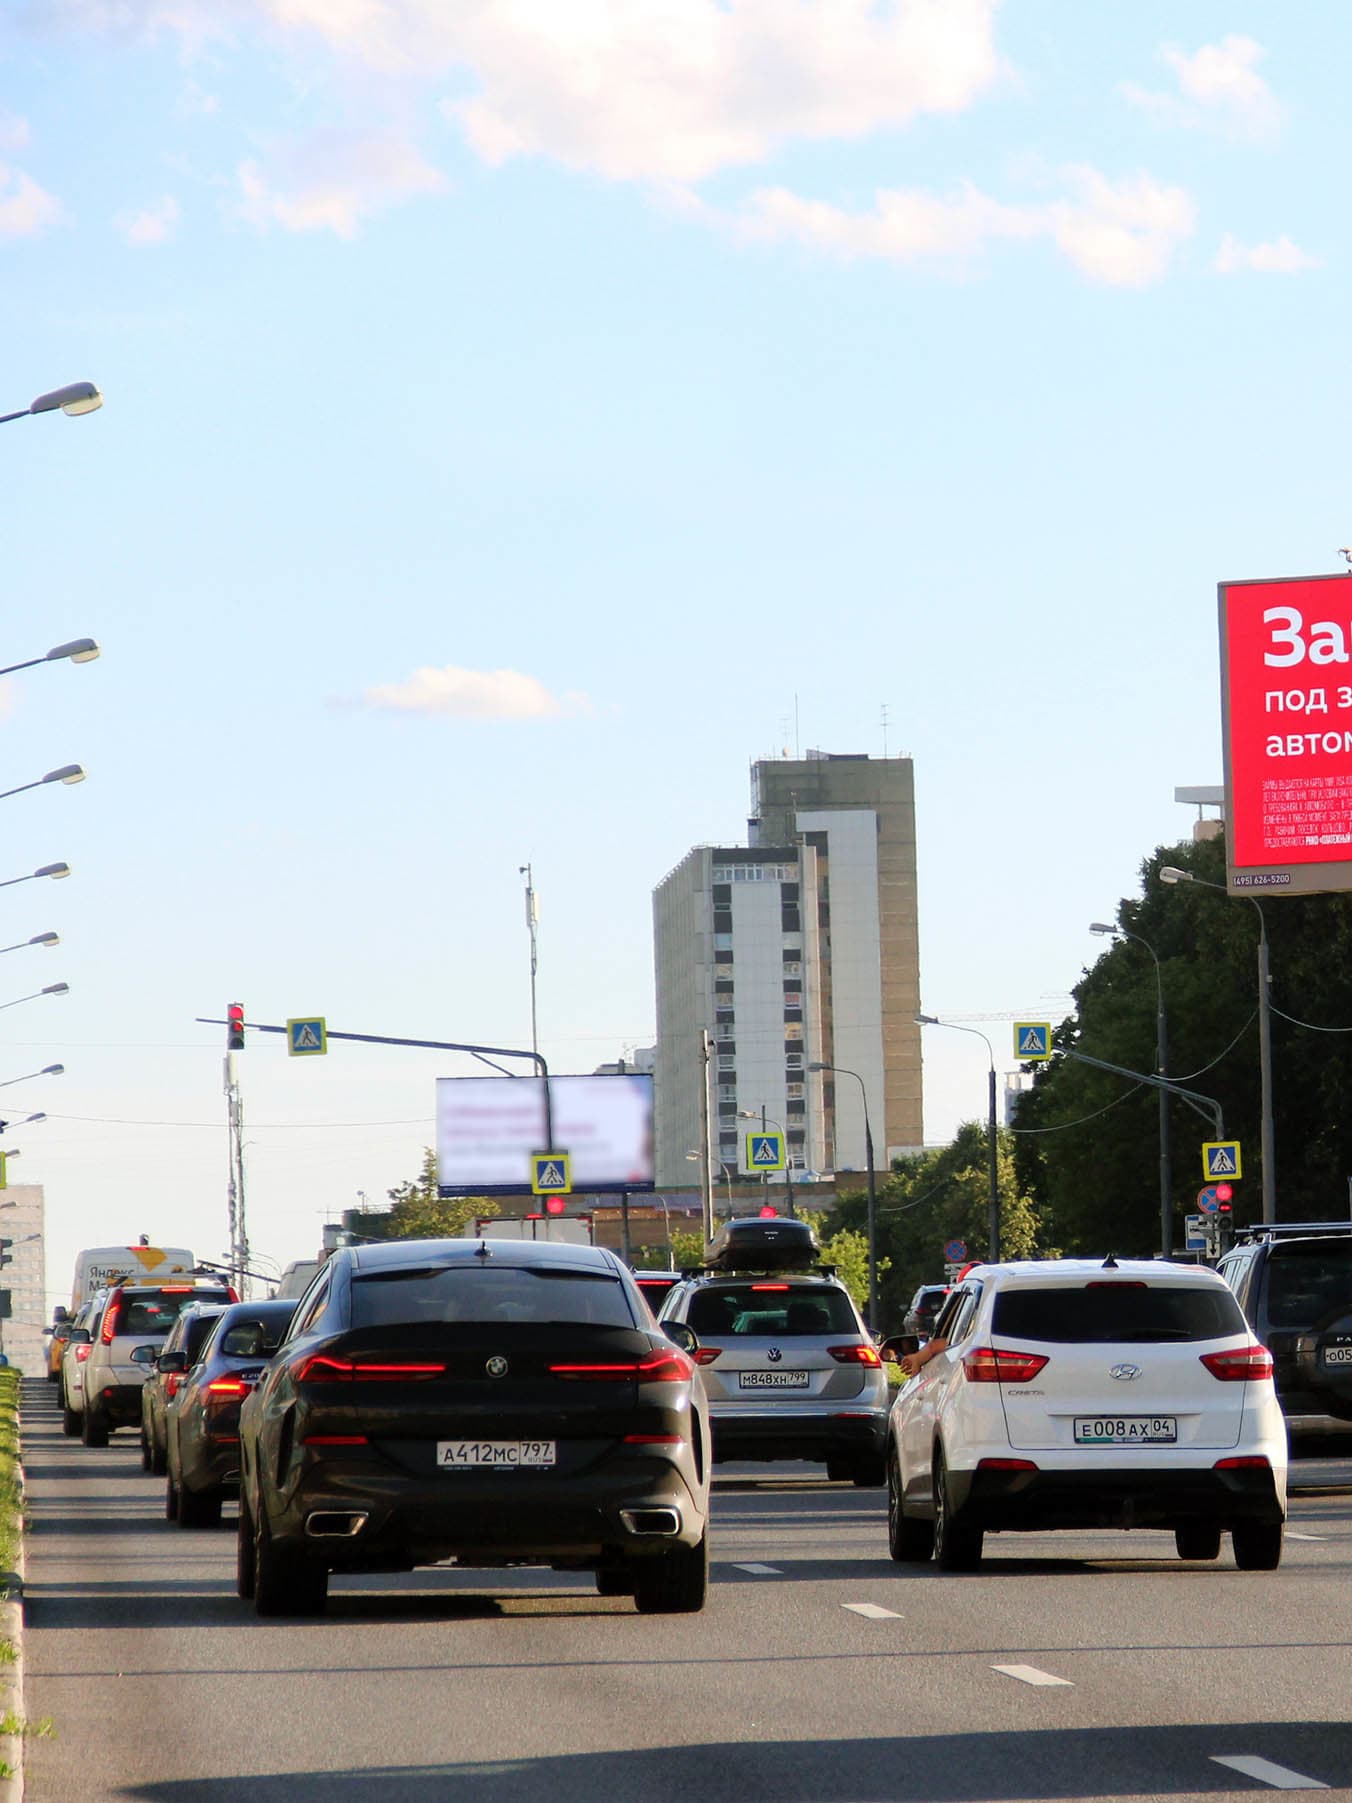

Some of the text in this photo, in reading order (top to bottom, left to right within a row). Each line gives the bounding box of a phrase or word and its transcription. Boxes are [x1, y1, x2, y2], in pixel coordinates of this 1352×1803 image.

[1265, 687, 1328, 714] под
[1233, 876, 1252, 886] (495)
[742, 1372, 806, 1385] М848ХН 799
[1082, 1420, 1170, 1437] Е008АХ 04
[443, 1442, 551, 1463] А412МС 797
